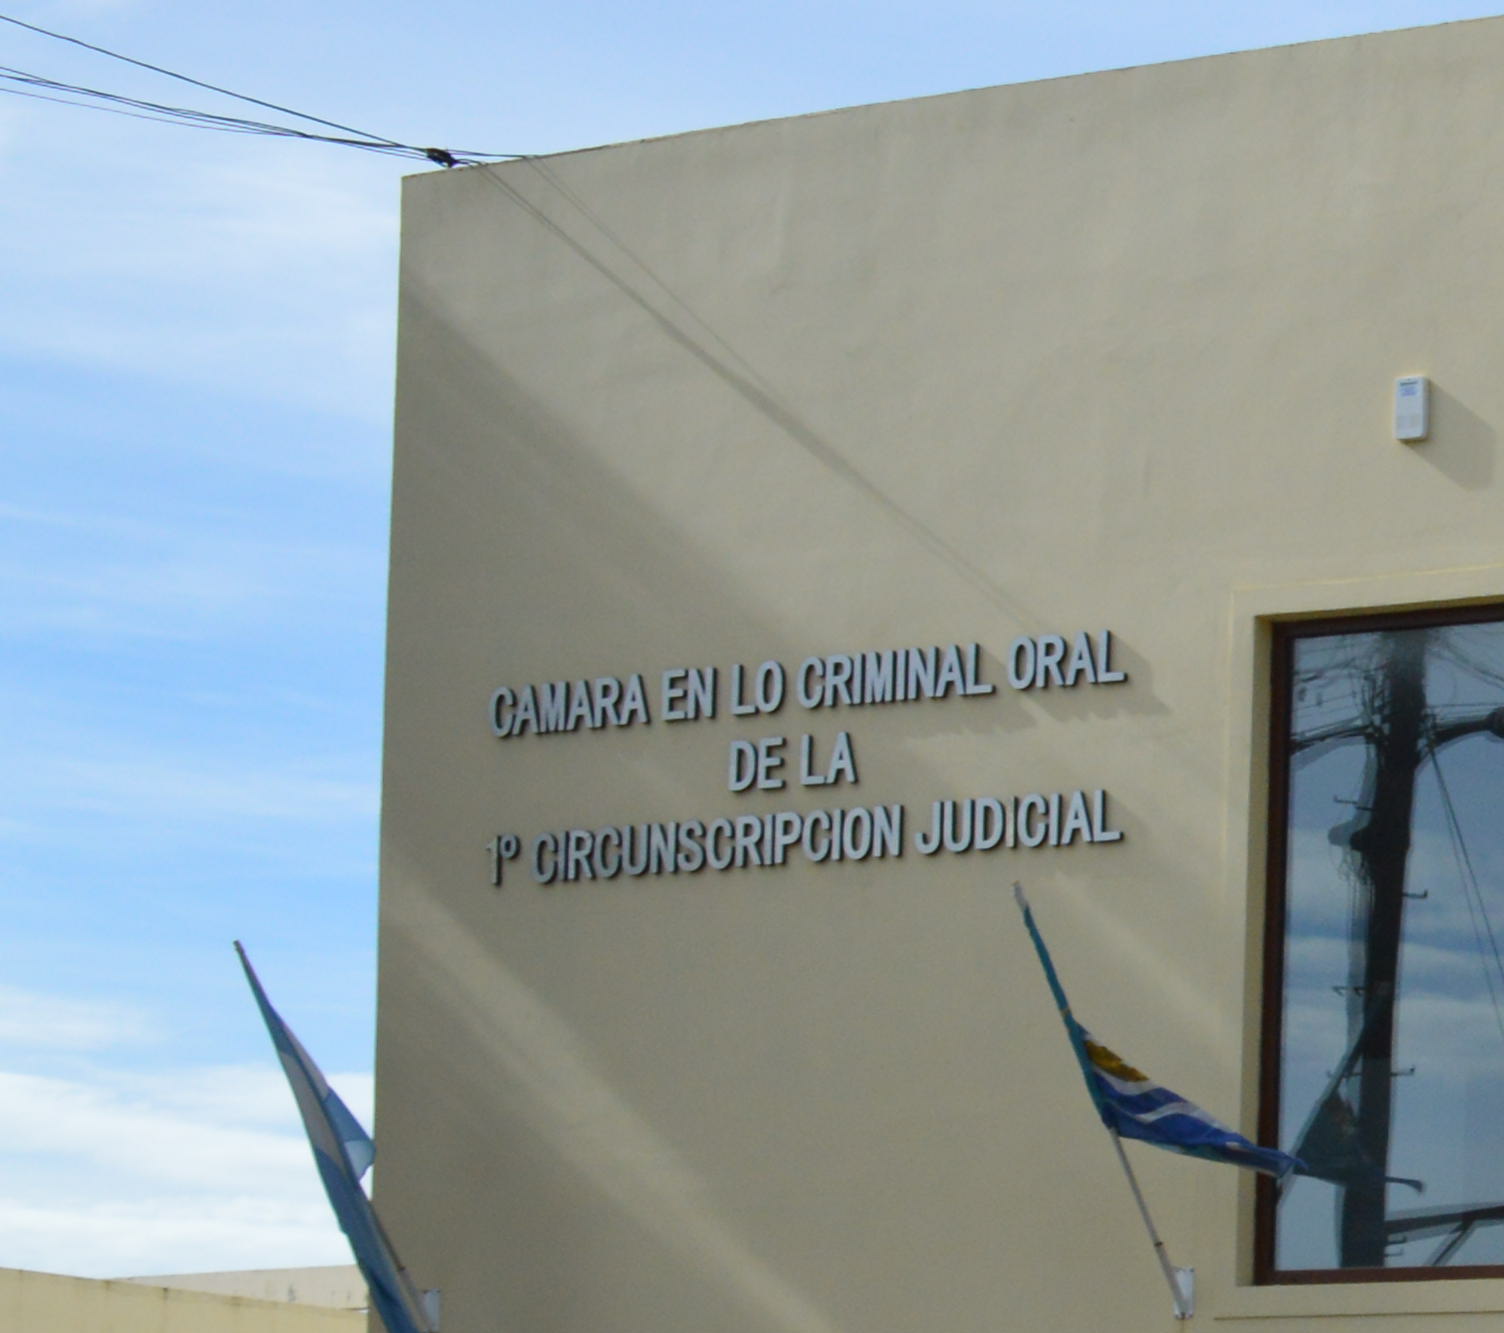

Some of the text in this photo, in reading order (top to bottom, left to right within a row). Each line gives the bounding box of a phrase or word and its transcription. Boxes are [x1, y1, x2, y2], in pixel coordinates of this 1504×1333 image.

[488, 629, 1129, 738] CAMARA EN LO CRIMINAL ORAL
[728, 731, 858, 792] DE LA
[531, 804, 903, 885] CIRCUNSCRIPCION
[914, 790, 1125, 856] JUDICIAL
